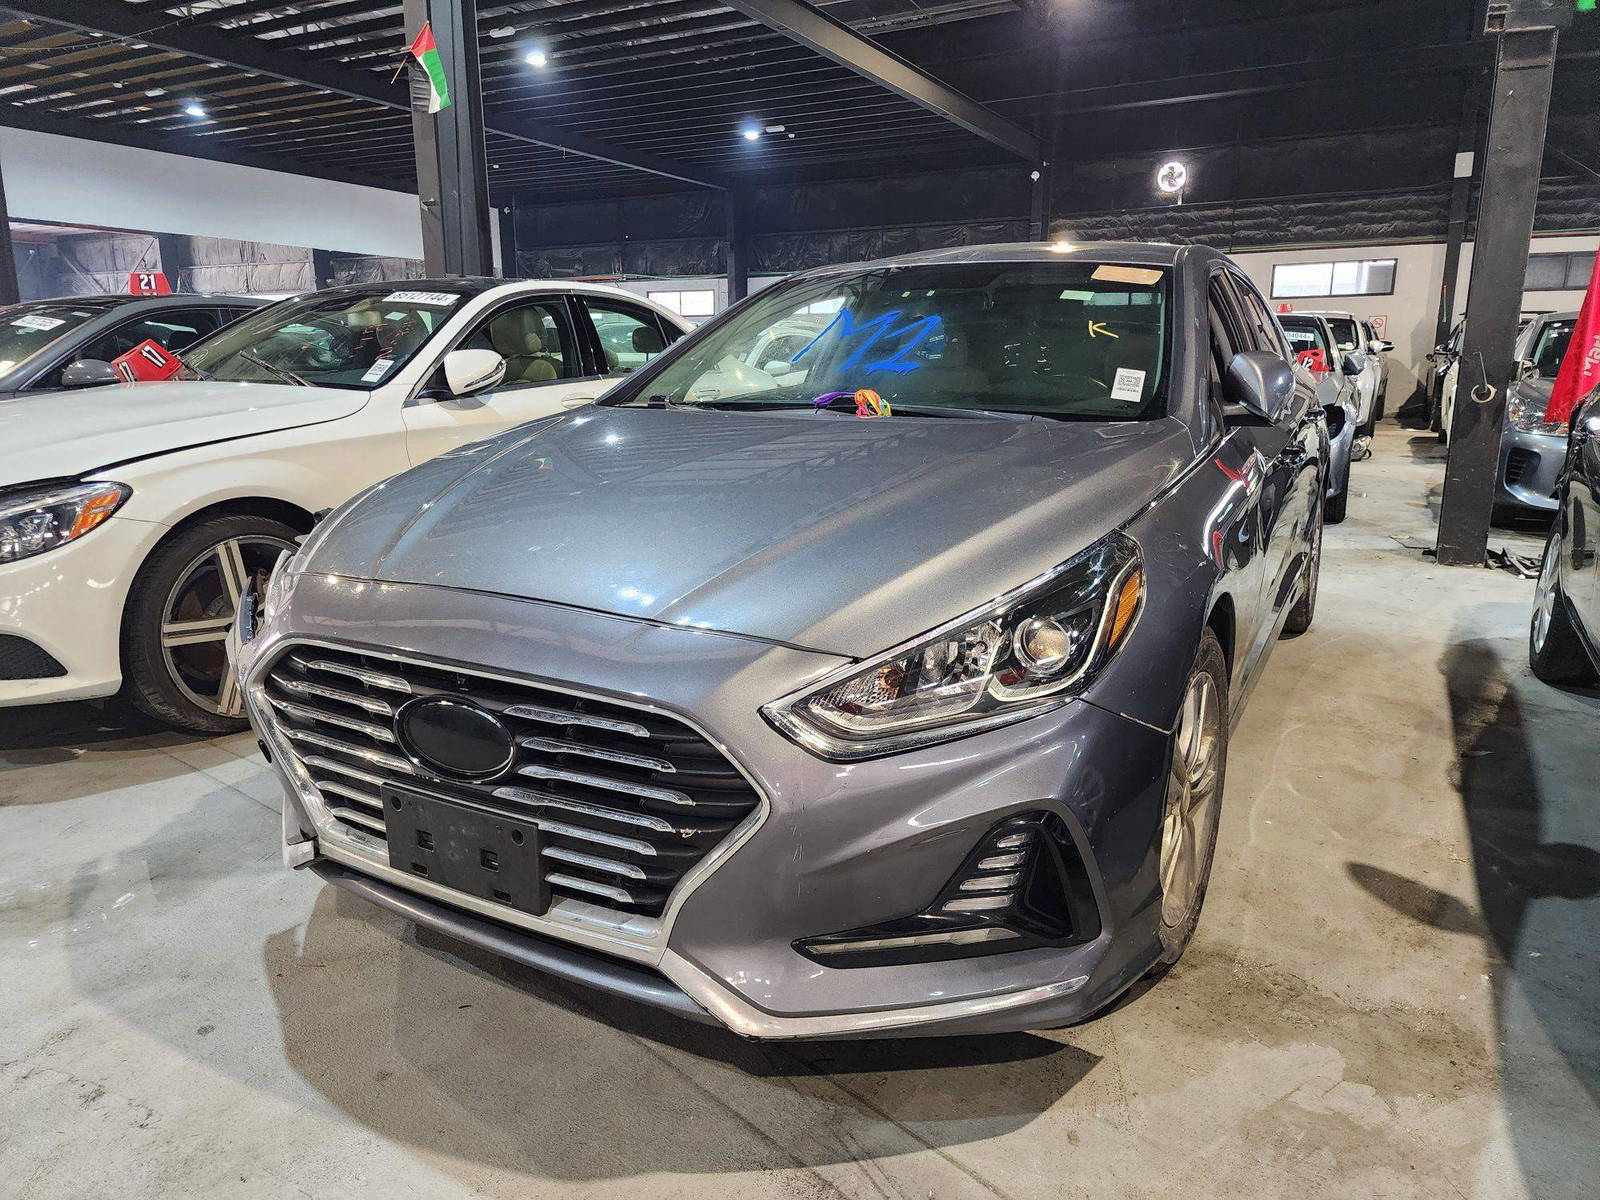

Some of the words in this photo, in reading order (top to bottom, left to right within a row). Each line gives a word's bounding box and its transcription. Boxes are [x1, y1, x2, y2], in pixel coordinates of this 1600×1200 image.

[139, 274, 156, 290] 21
[141, 345, 166, 368] 17
[1301, 356, 1314, 370] 12
